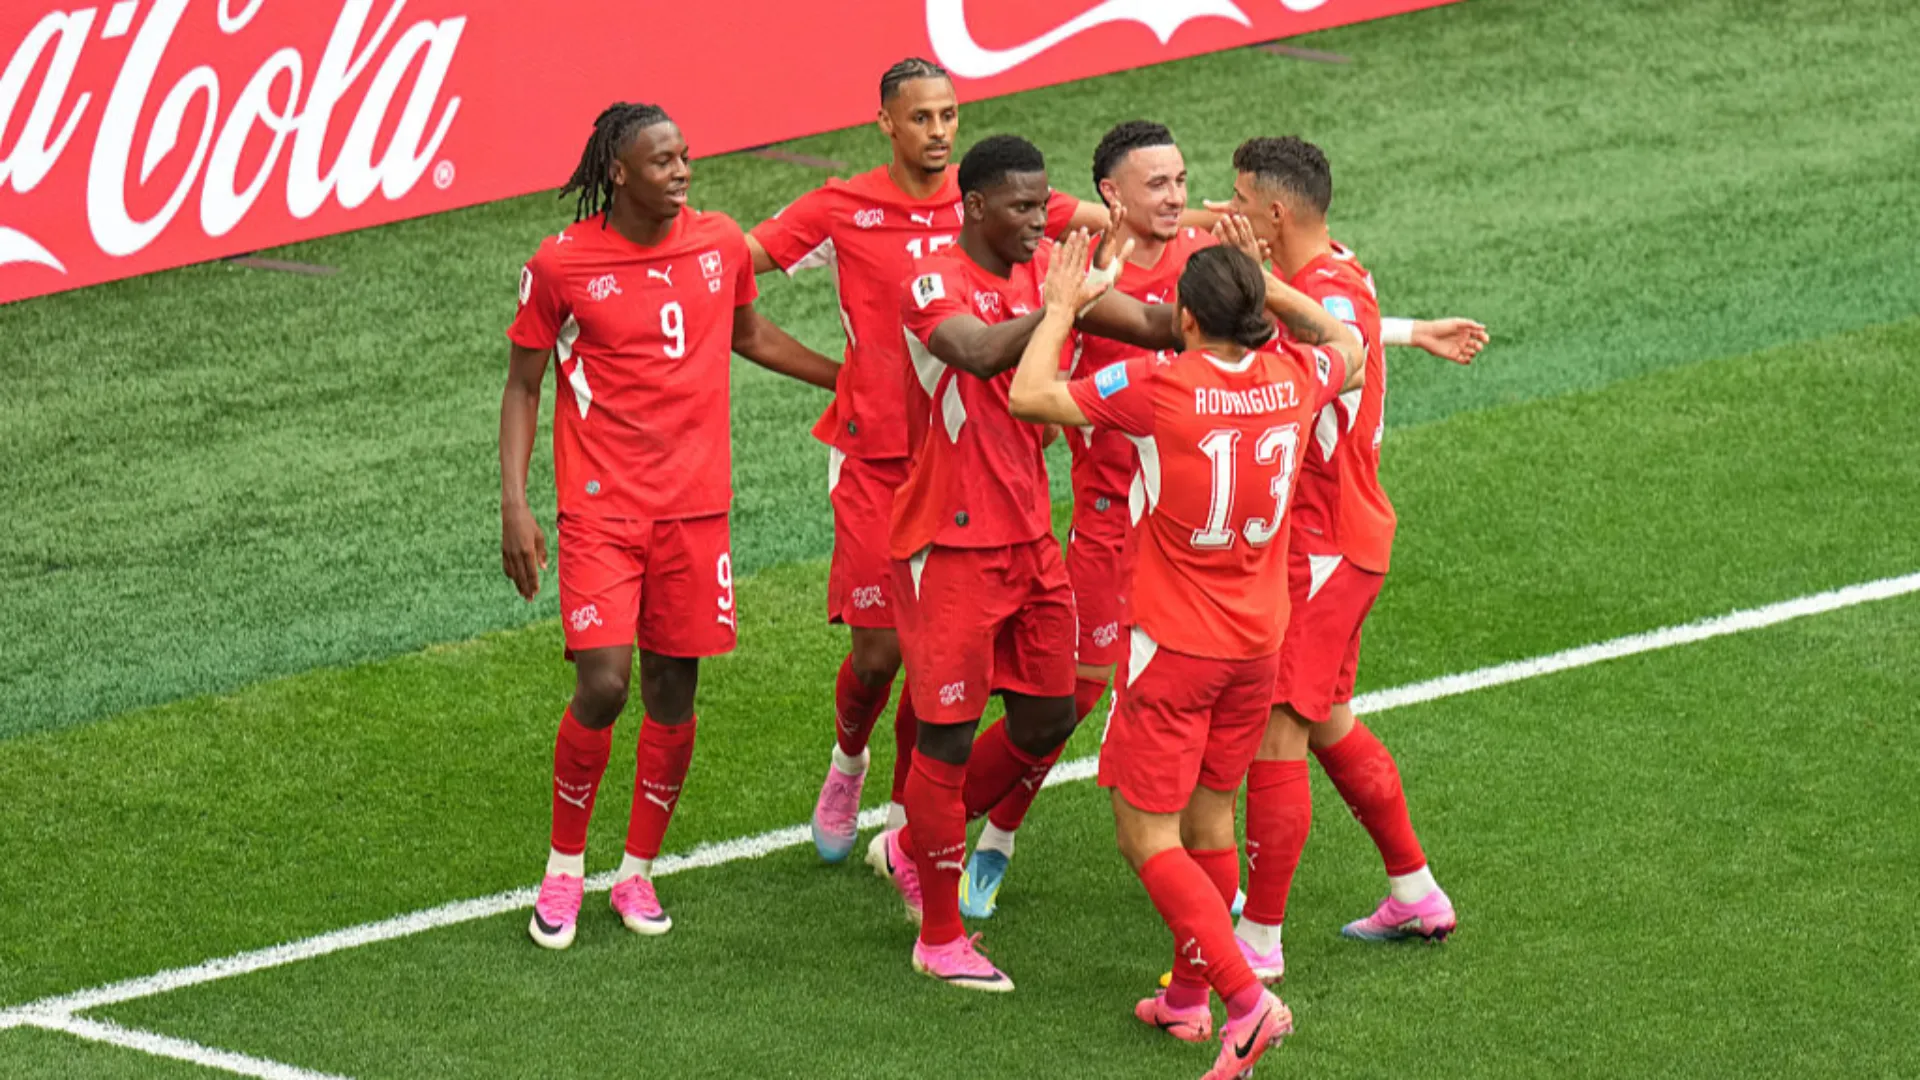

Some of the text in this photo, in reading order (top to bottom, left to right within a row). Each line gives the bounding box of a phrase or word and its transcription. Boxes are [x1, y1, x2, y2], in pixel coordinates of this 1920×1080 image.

[660, 301, 685, 358] 9
[1195, 380, 1299, 415] RODRIGUEZ
[1191, 422, 1300, 550] 13
[717, 552, 735, 611] 9
